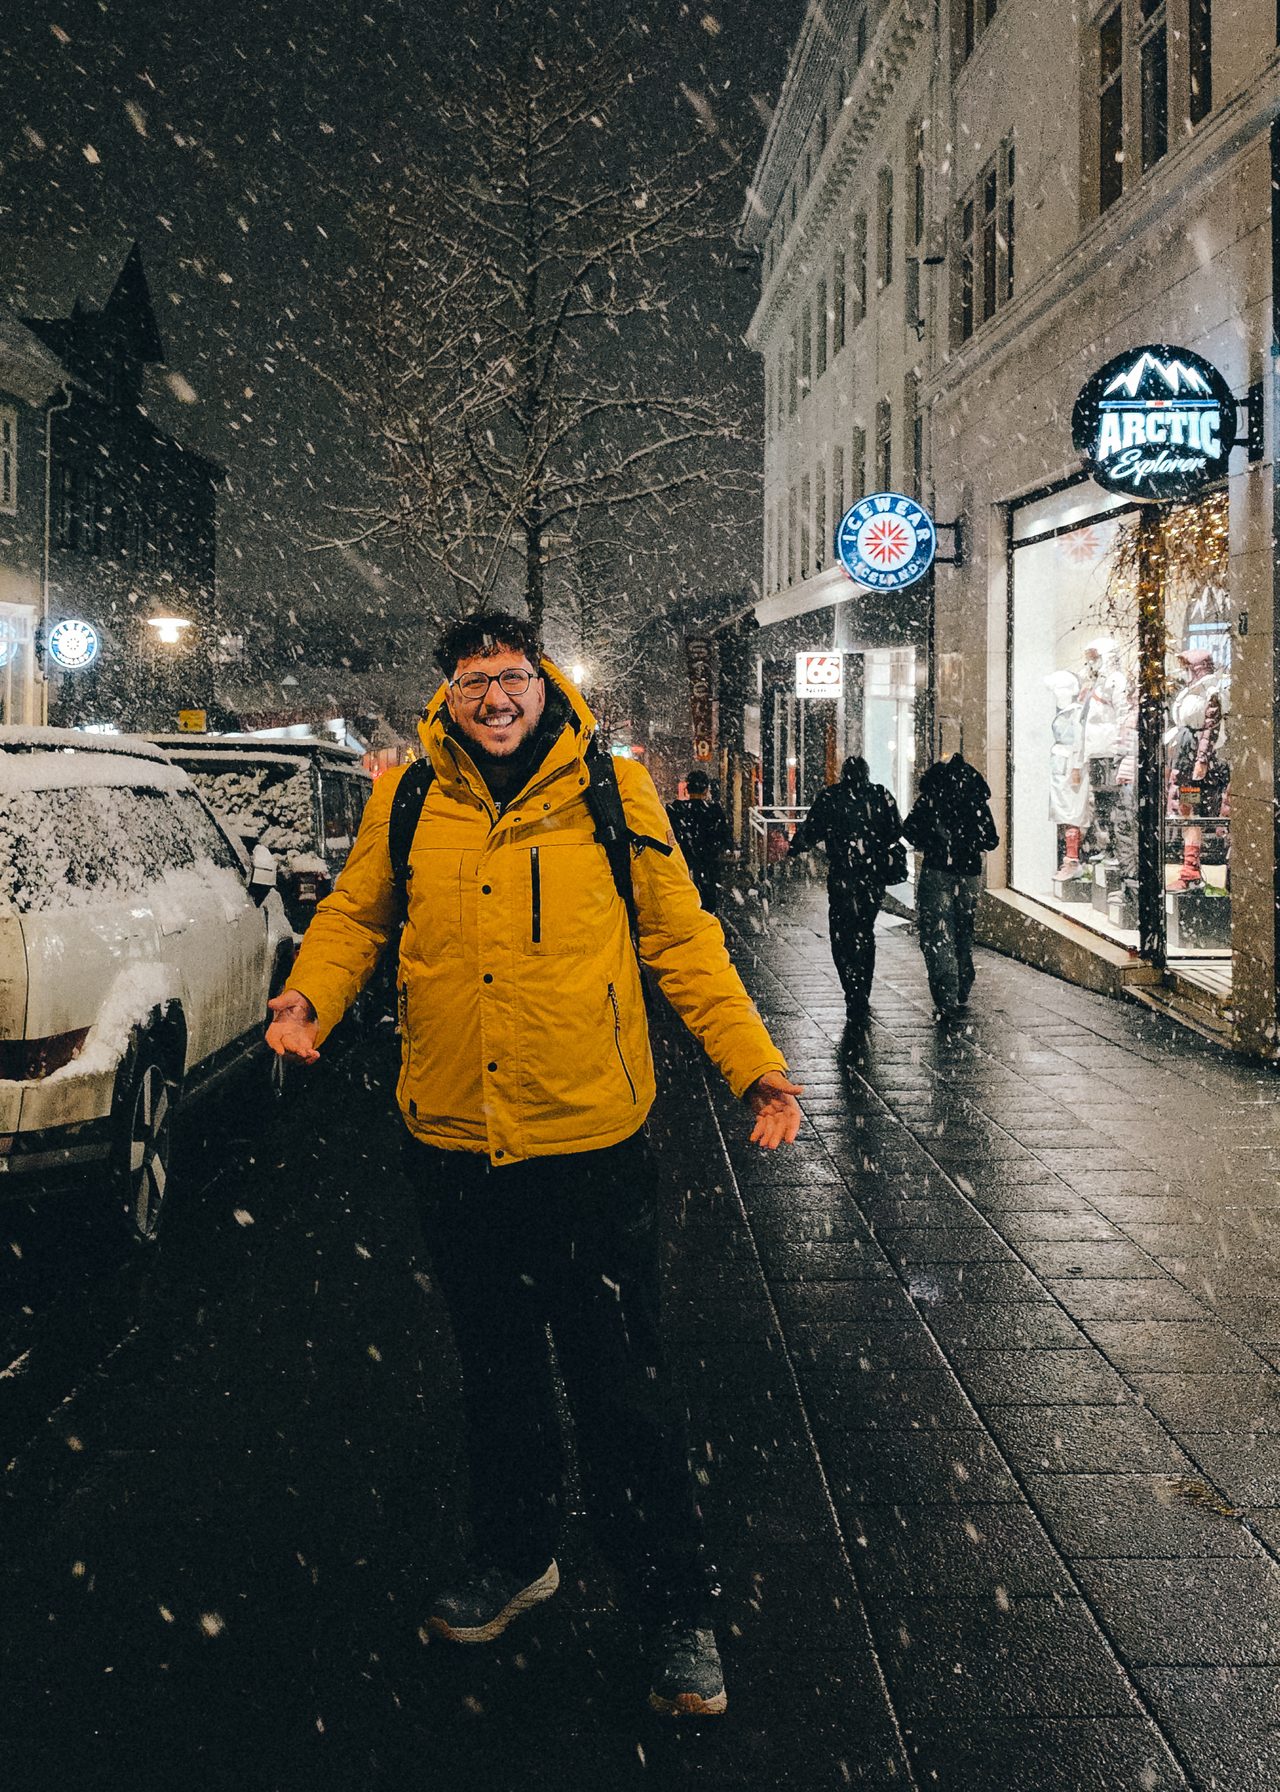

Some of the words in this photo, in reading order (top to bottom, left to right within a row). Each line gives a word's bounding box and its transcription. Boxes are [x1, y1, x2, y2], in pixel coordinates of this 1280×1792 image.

[1098, 411, 1221, 461] ARCTIC
[1109, 448, 1206, 486] Explorer
[843, 497, 931, 542] ICEWEAR
